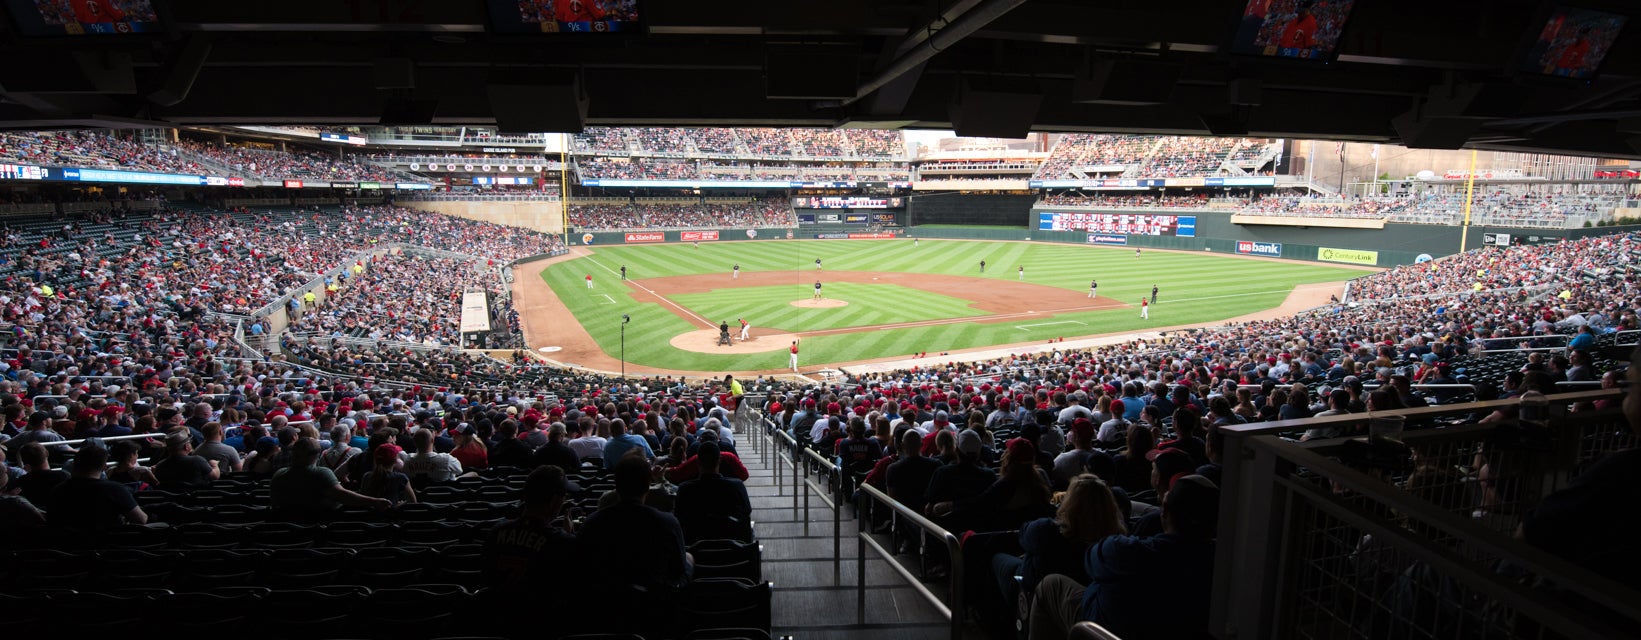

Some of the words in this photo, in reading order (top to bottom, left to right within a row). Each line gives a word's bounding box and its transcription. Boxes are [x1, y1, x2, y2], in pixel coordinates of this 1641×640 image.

[414, 126, 432, 134] TWINS
[1334, 252, 1372, 261] CenturyLink
[496, 528, 547, 552] MAUER
